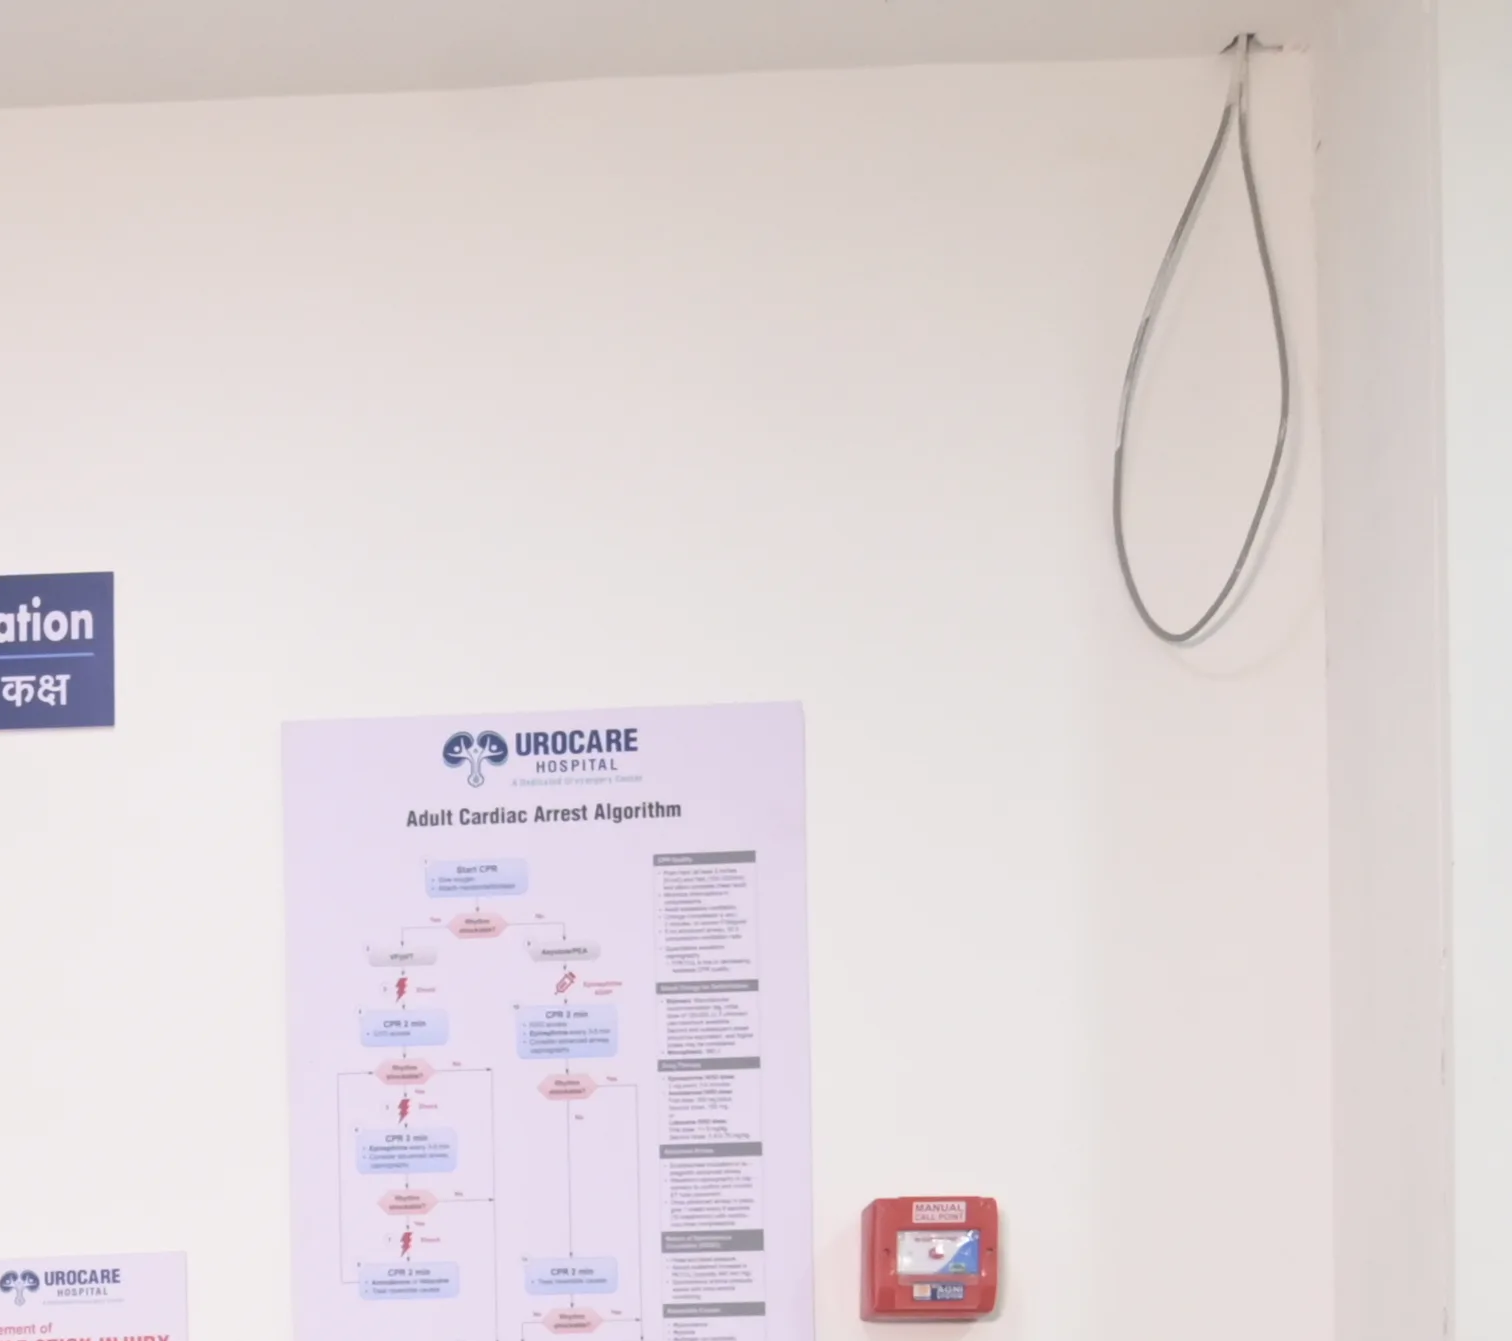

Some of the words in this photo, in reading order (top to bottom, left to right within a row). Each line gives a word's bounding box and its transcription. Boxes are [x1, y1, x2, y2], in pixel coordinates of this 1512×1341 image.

[1, 672, 70, 707] कक्ष
[515, 728, 637, 756] UROCARE
[536, 758, 618, 773] HOSPITAL
[407, 808, 453, 828] Adult
[459, 807, 527, 826] Cardiac
[534, 805, 587, 823] Arrest
[593, 800, 681, 823] Algorithm
[457, 866, 476, 874] Start
[479, 865, 497, 873] CPR
[915, 1204, 963, 1212] MANUAL
[44, 1269, 121, 1286] UROCARE
[57, 1288, 108, 1297] HOSPITAL
[40, 1323, 53, 1334] of
